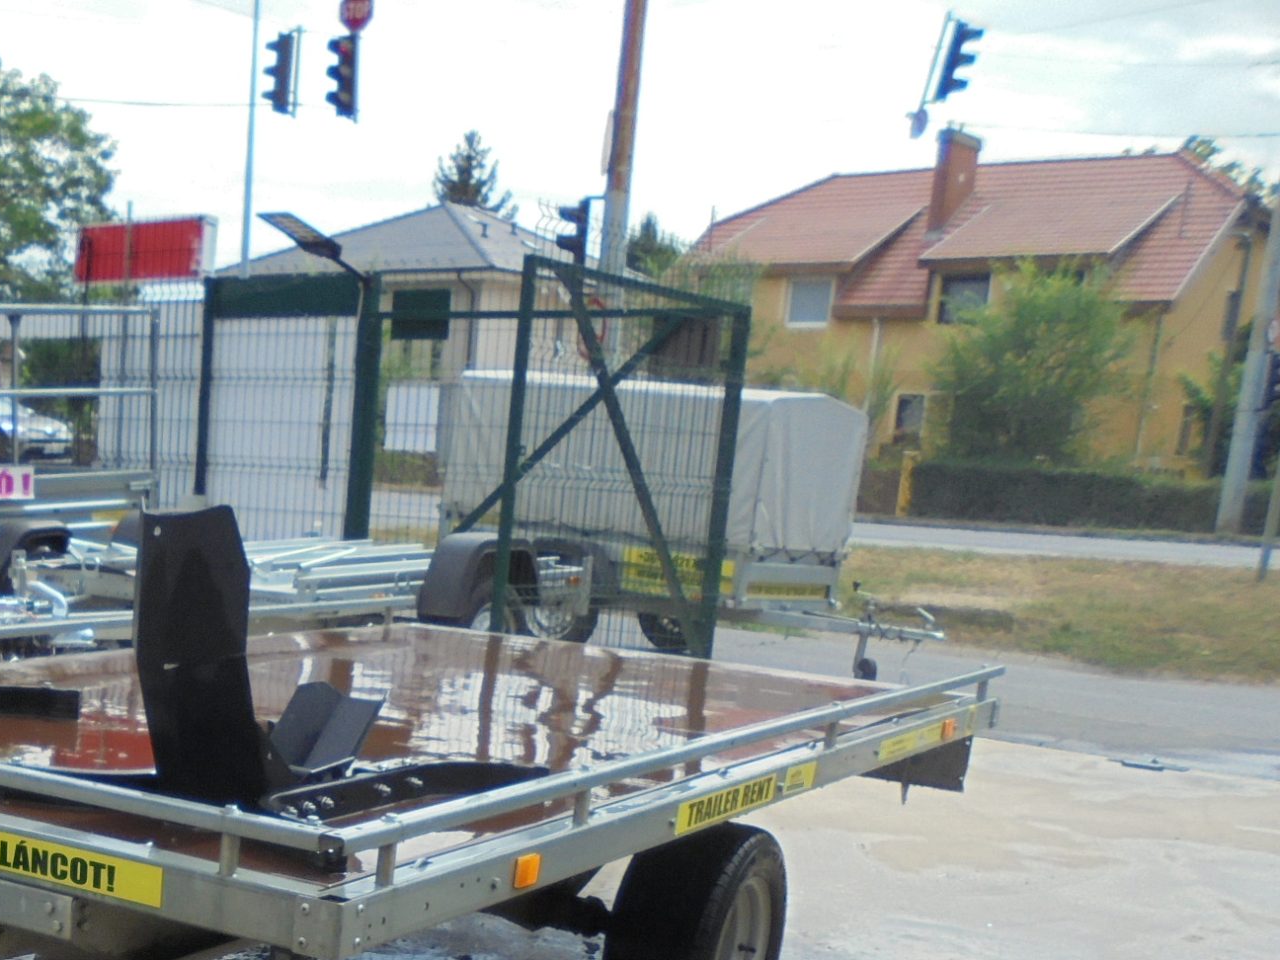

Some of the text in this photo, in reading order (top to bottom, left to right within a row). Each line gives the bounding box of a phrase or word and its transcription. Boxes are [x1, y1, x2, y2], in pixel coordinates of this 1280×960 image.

[688, 784, 741, 827] TRAILER
[741, 776, 774, 807] RENT
[0, 835, 116, 892] LÁNCOT!
